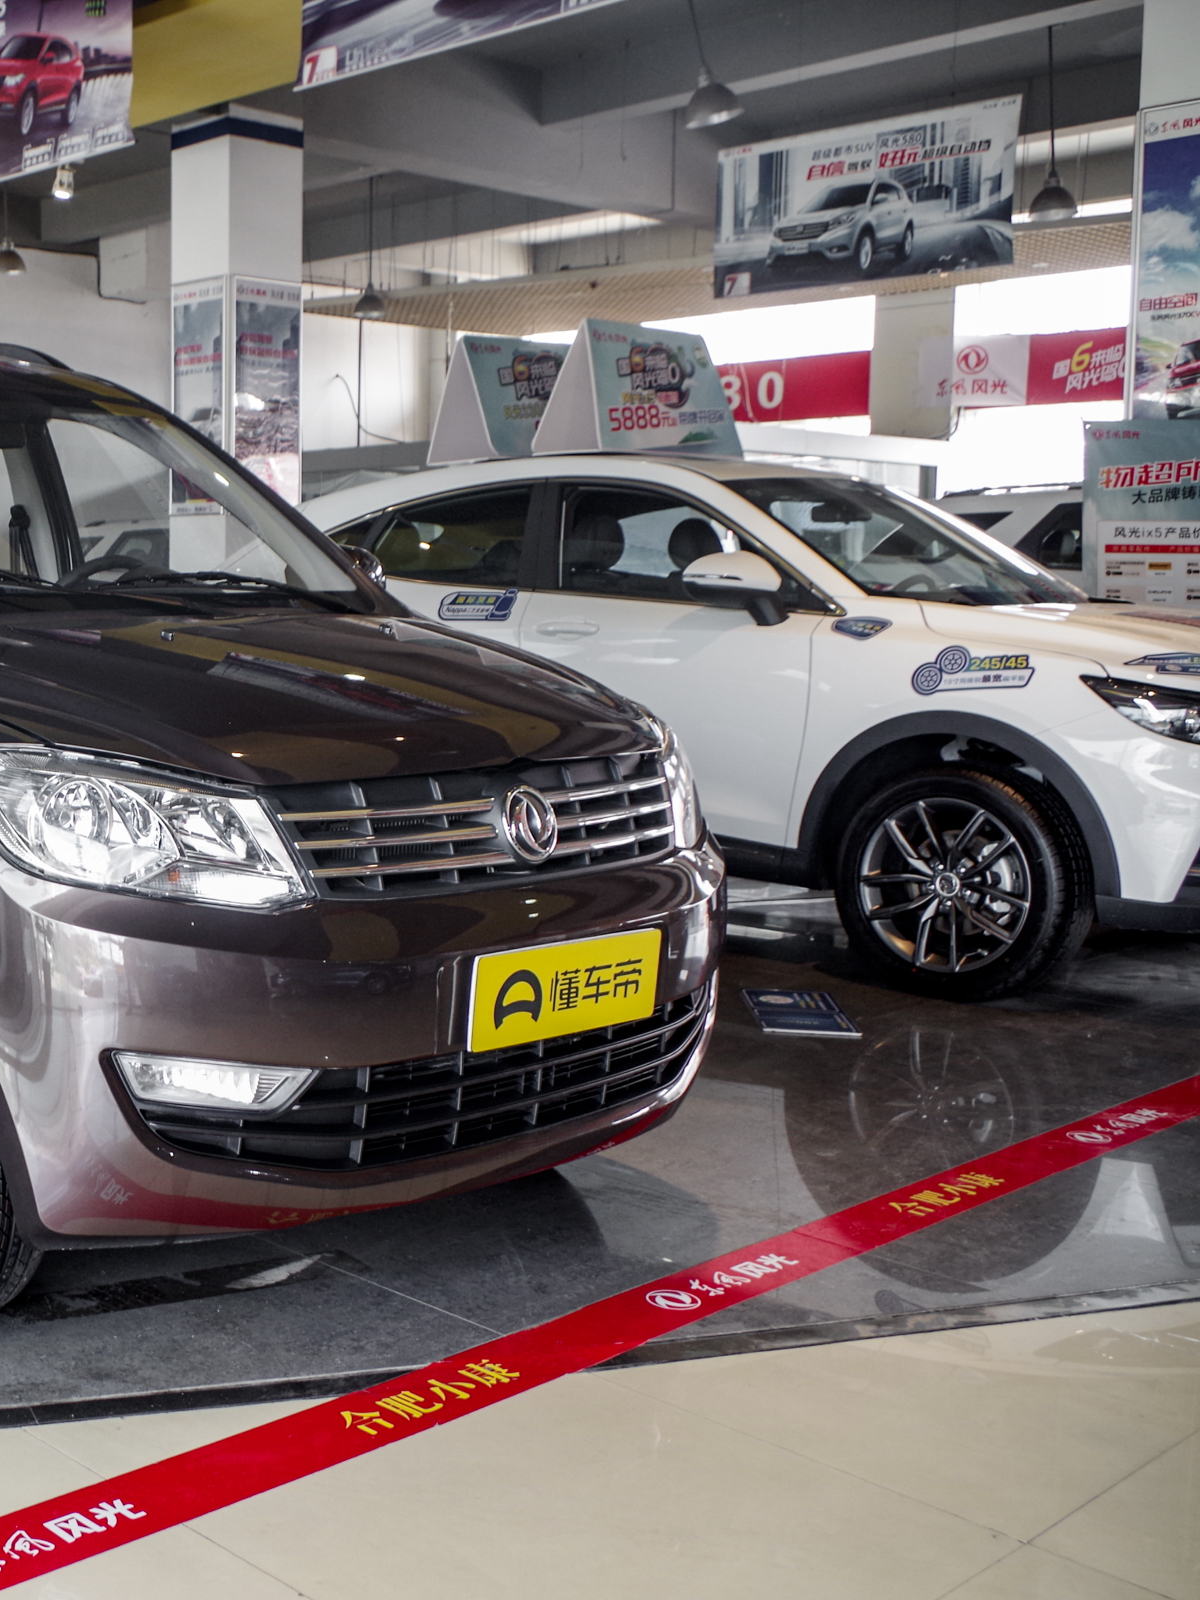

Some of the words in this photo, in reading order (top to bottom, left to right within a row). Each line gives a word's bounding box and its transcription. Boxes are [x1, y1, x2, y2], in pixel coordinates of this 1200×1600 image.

[724, 276, 738, 296] 7
[1139, 292, 1198, 312] 自由空间
[1052, 341, 1125, 380] 国6来临
[1132, 485, 1200, 505] 大品牌铸
[970, 656, 1028, 671] 245/45
[340, 1358, 521, 1436] 合肥小康
[888, 1171, 1006, 1217] 合肥小康
